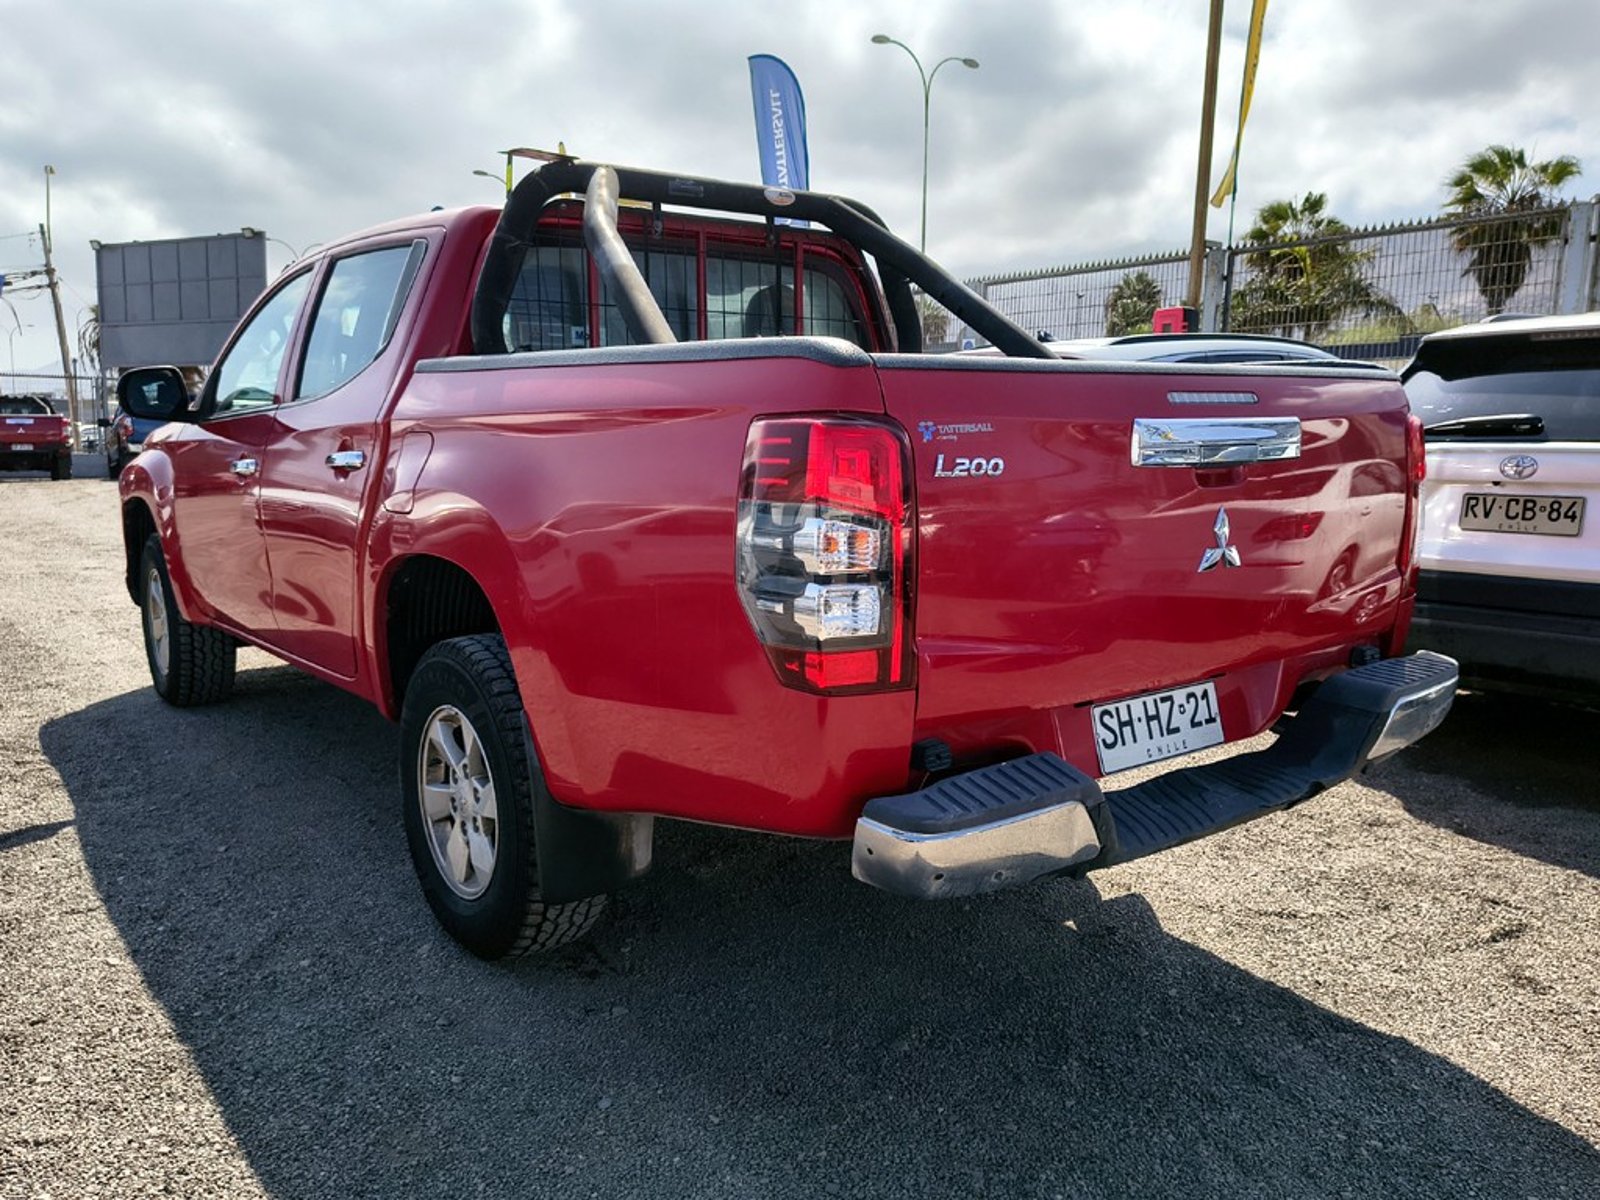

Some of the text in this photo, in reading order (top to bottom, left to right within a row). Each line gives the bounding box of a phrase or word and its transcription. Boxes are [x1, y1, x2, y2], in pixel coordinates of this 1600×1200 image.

[937, 423, 994, 434] TATTERSALL
[934, 454, 1005, 478] L200
[1146, 739, 1188, 759] CHILE
